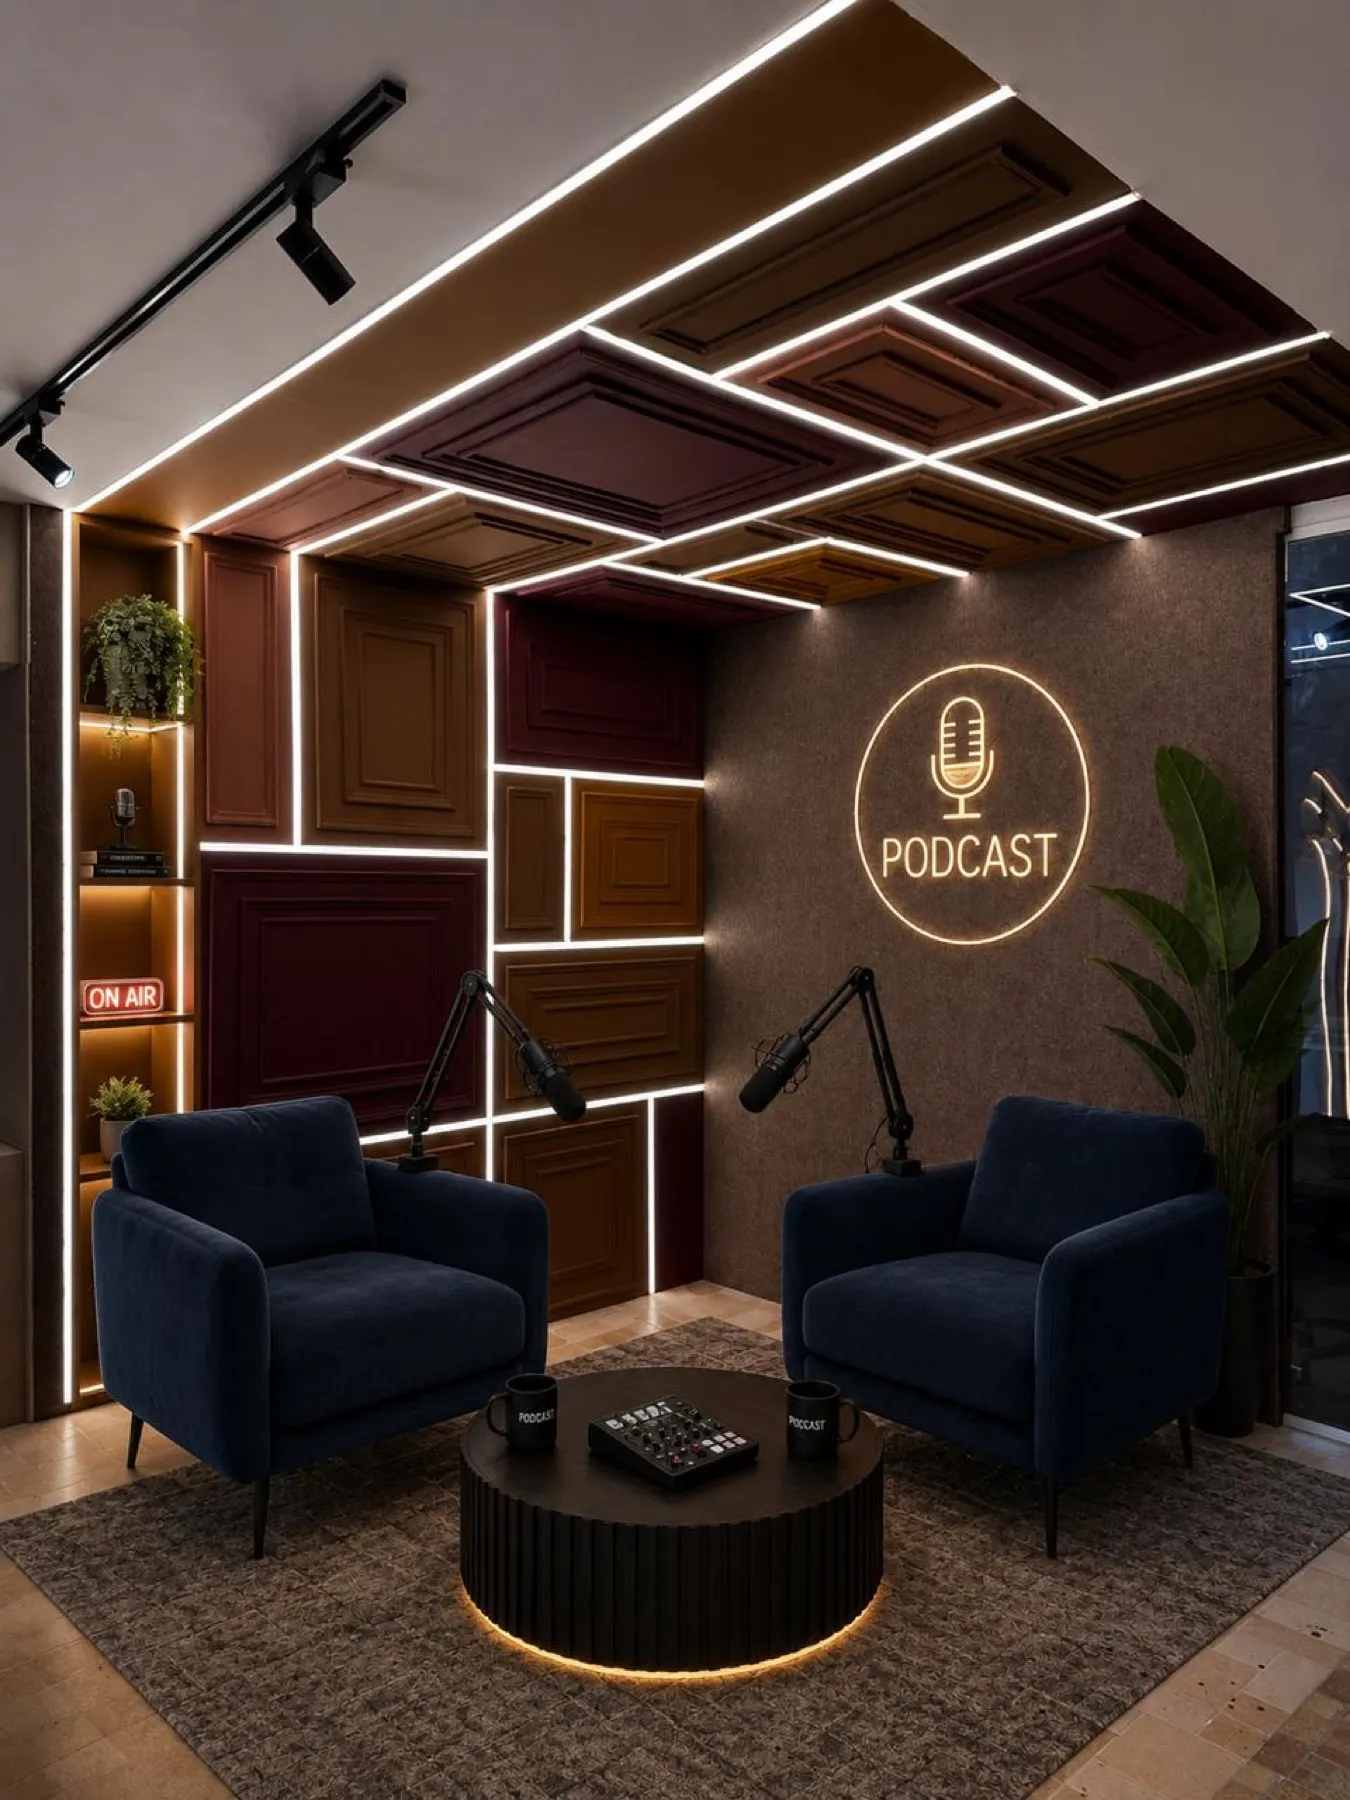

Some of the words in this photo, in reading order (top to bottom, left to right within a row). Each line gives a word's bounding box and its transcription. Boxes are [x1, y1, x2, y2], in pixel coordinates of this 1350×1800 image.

[882, 833, 1058, 878] PODCAST
[89, 987, 119, 1009] ON
[124, 985, 156, 1008] AIR
